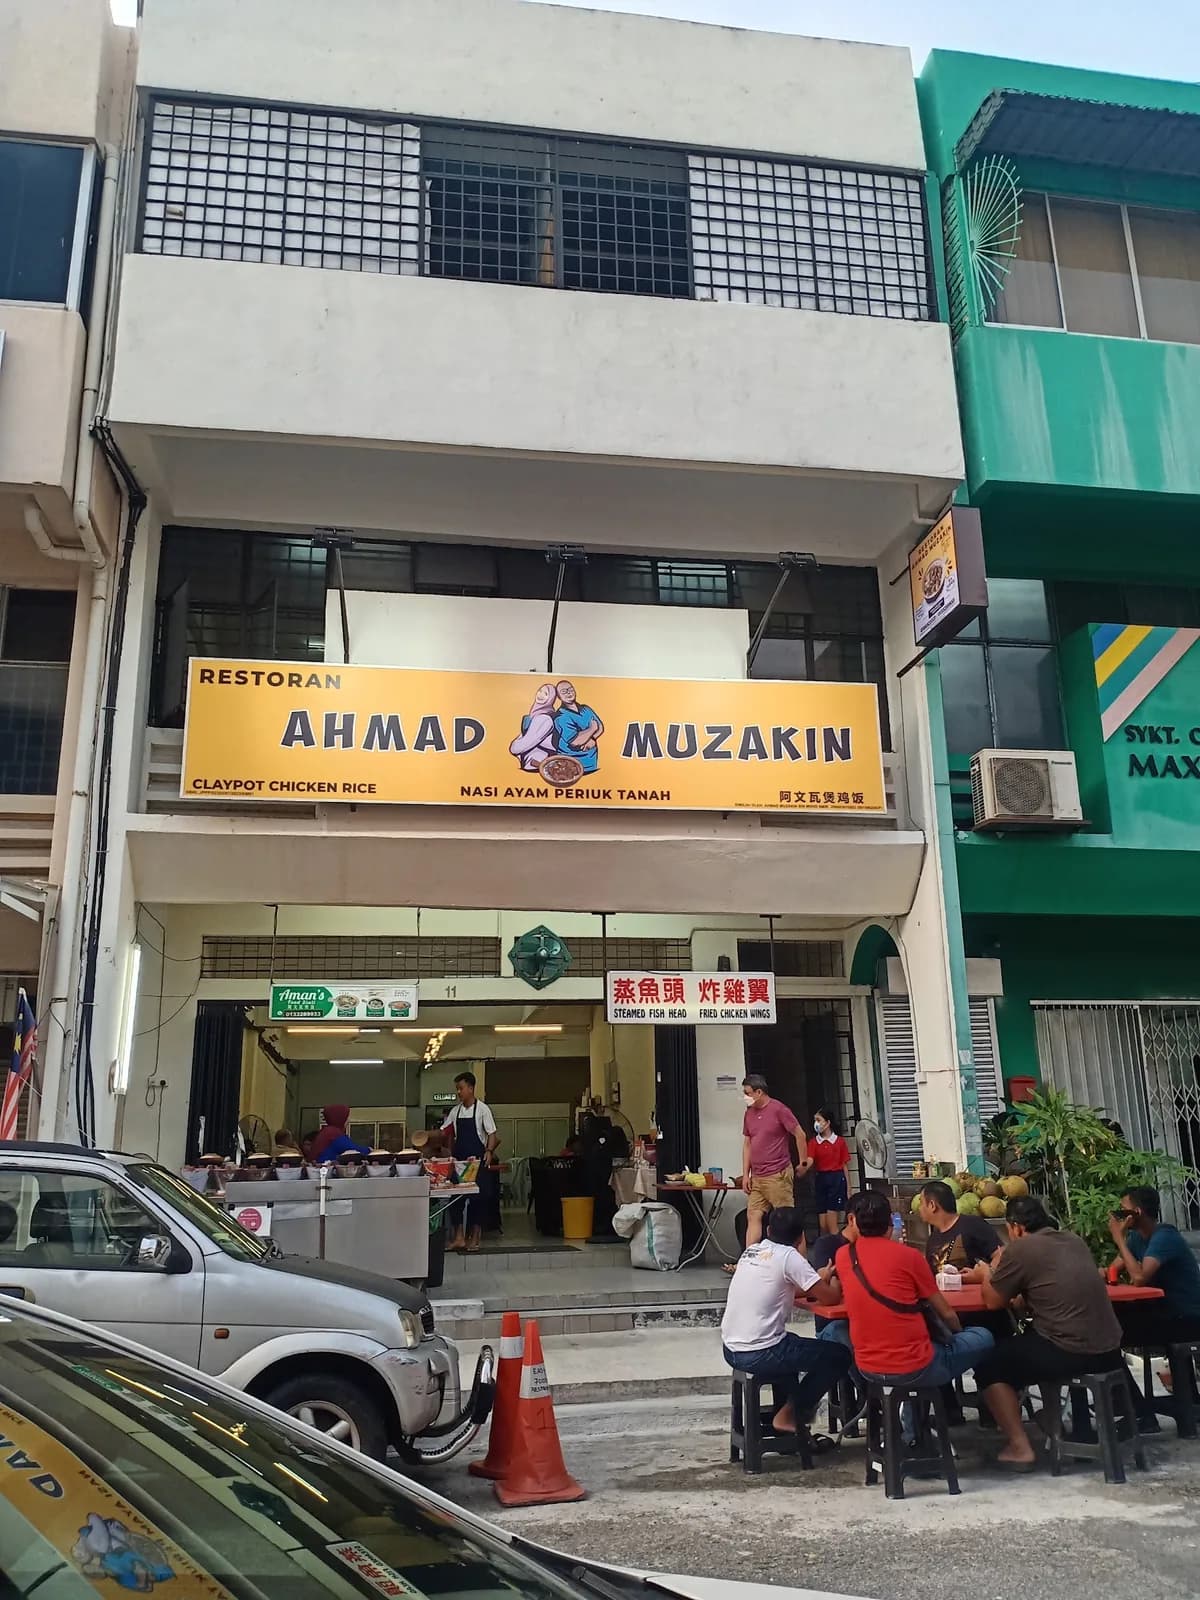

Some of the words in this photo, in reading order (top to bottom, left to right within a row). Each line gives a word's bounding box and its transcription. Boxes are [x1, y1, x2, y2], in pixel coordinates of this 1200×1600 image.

[199, 668, 342, 690] RESTORAN
[280, 709, 487, 753] AHMAD
[620, 720, 854, 764] MUZAKIN
[1124, 724, 1181, 745] SYKT.
[192, 778, 265, 791] CLAYPOT
[269, 781, 338, 793] CHICKEN
[342, 783, 377, 794] RICE
[460, 786, 498, 797] NASI
[504, 787, 548, 799] AYAM
[554, 788, 612, 800] PERIUK
[616, 789, 671, 801] TANAH
[779, 790, 865, 804] 阿文瓦煲鸡饭
[278, 988, 325, 1001] Aman's
[445, 985, 457, 998] 11
[613, 977, 686, 1004] 蒸魚頭
[698, 978, 770, 1004] 炸雞翼
[613, 1008, 646, 1019] STEAMED
[649, 1008, 665, 1019] FISH
[668, 1008, 687, 1019] HEAD
[699, 1008, 718, 1019] FRIED
[720, 1008, 748, 1019] CHICKEN
[750, 1008, 771, 1019] WINGS
